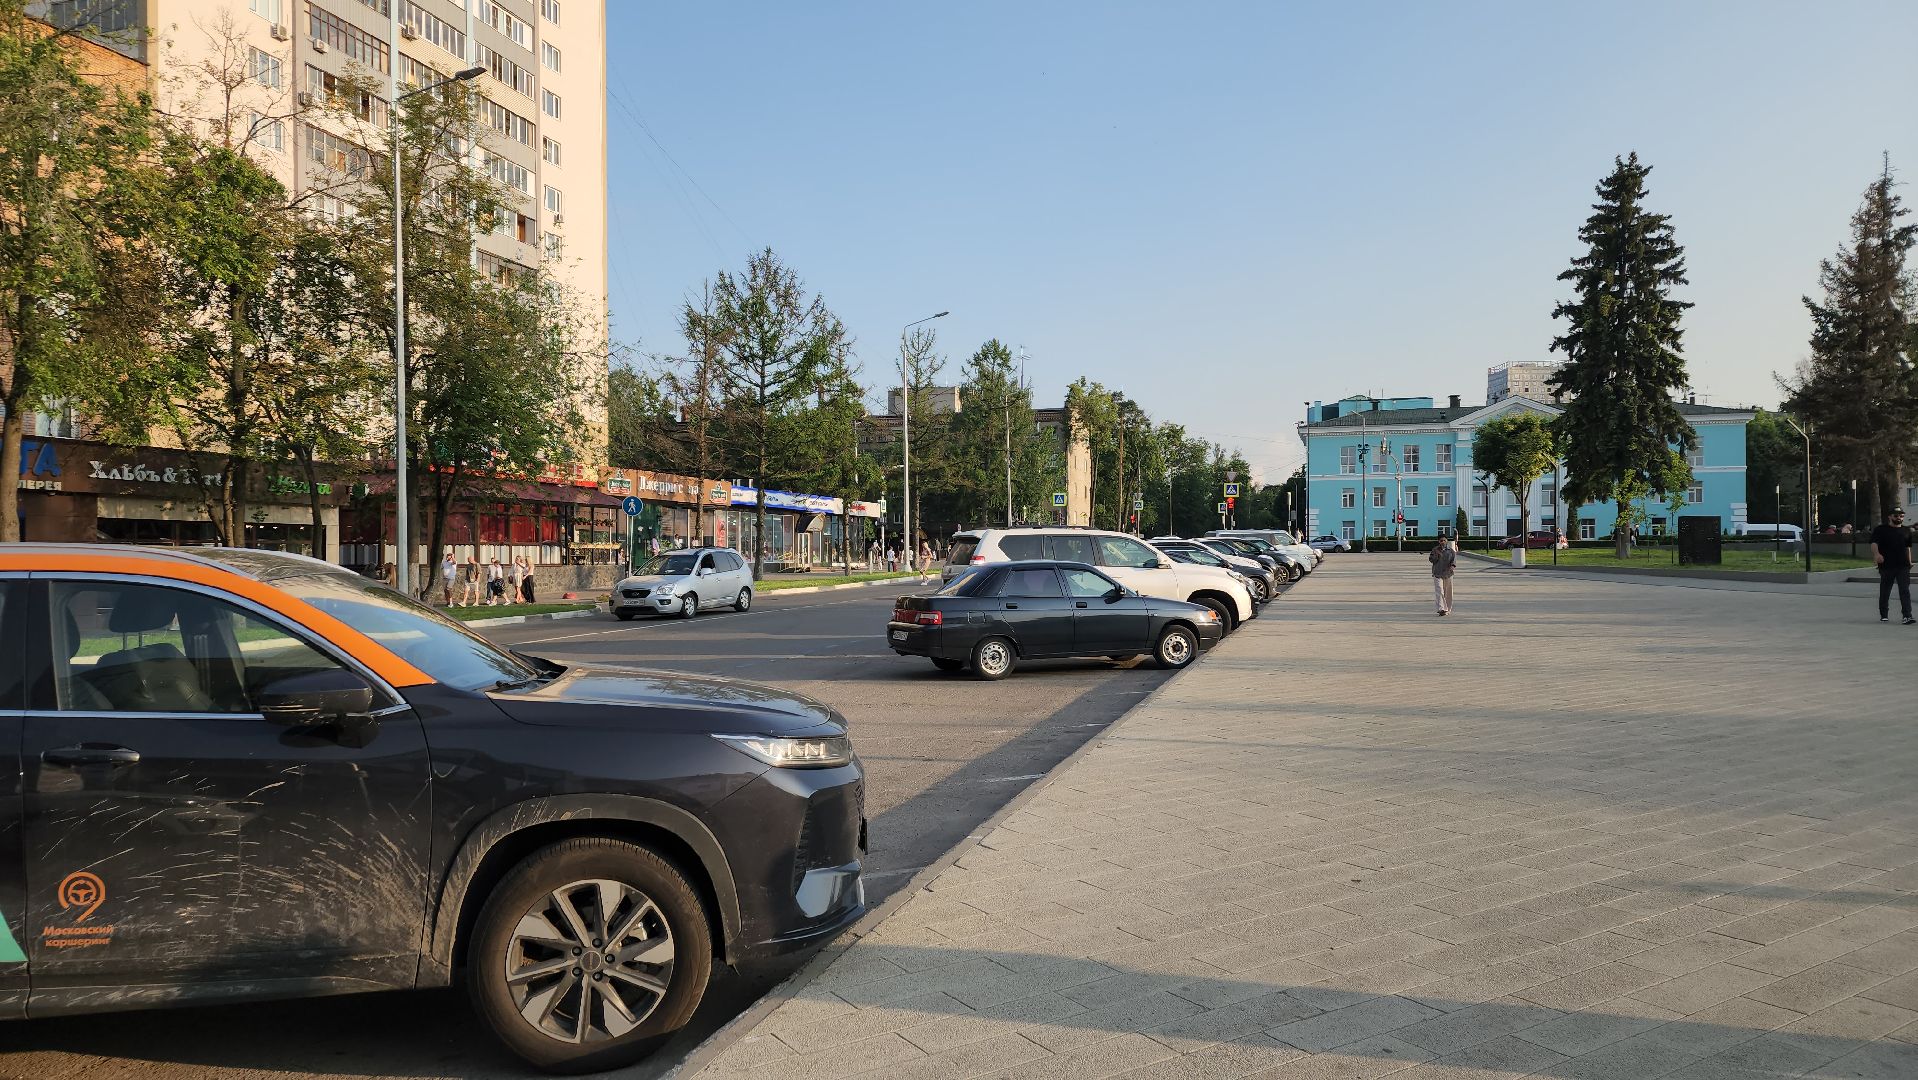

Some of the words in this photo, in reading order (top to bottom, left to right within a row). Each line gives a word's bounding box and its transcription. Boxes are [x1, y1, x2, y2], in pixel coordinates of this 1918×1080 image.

[0, 438, 62, 477] ГА
[16, 480, 62, 491] ЛЕРЕЯ
[42, 924, 114, 936] Московский
[45, 937, 111, 949] каршеринг
